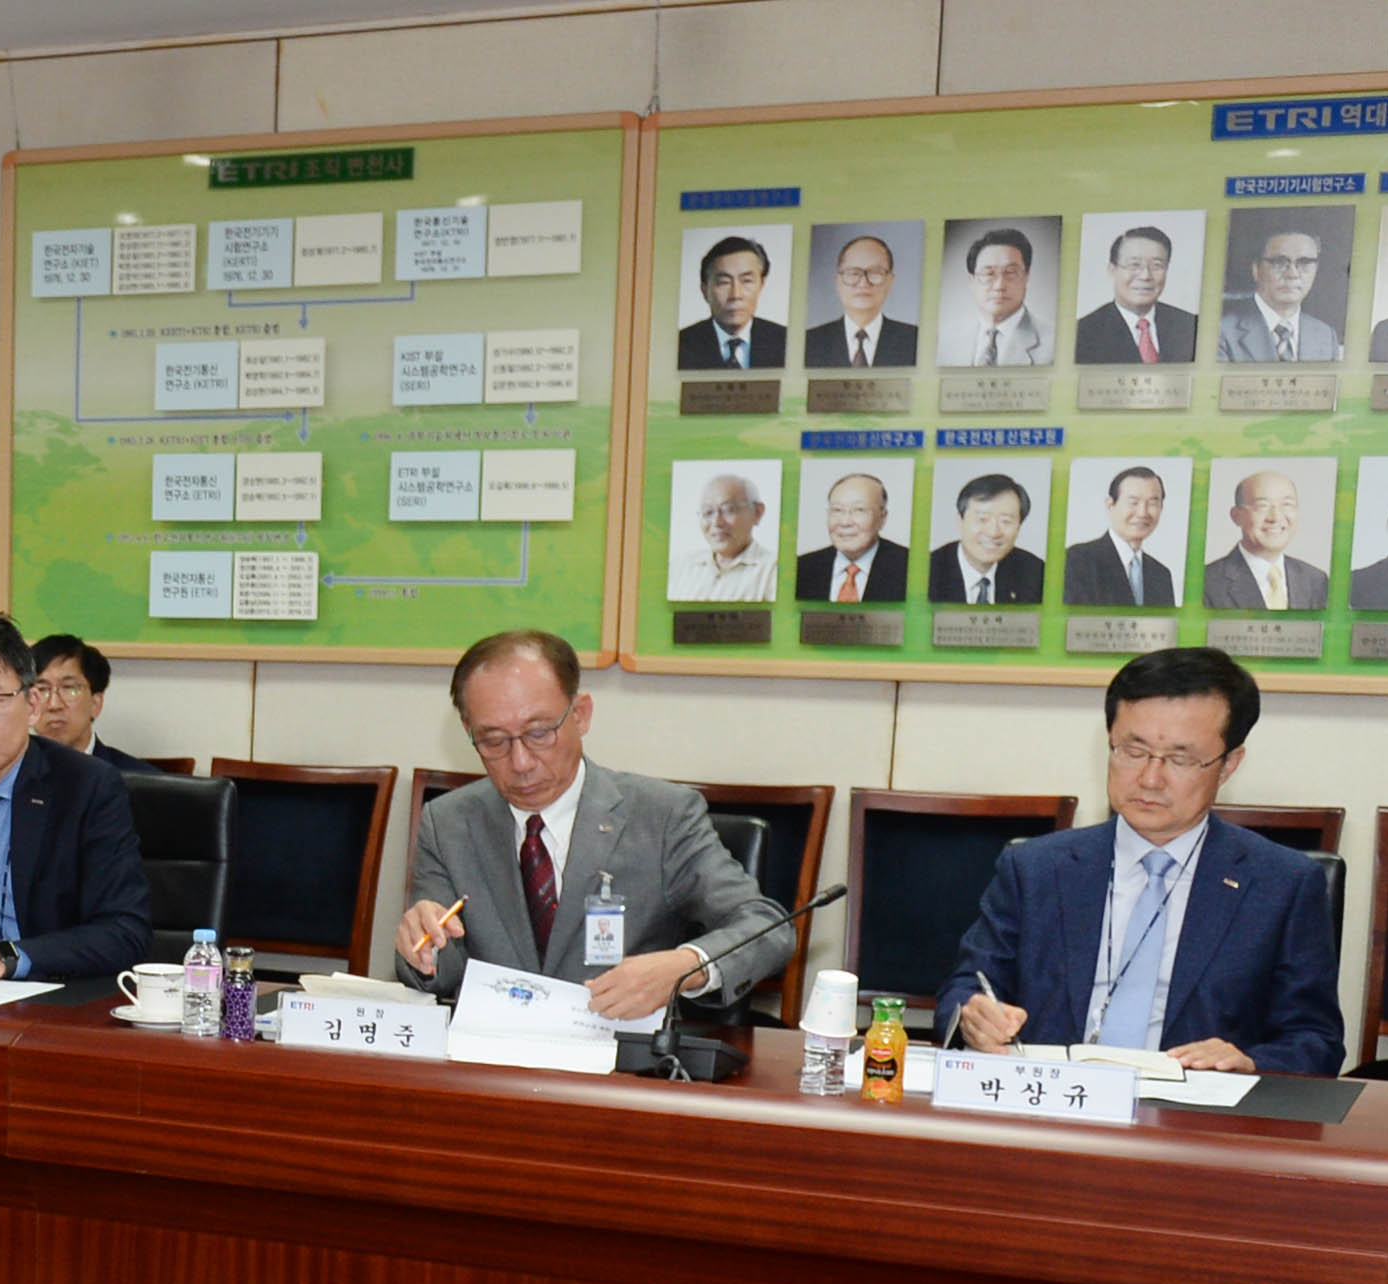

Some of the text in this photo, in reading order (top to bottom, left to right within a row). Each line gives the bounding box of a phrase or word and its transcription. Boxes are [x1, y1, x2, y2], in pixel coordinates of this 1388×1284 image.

[1226, 102, 1387, 131] ETRI 역대
[217, 160, 299, 183] ETRI
[290, 1000, 316, 1011] ETRI
[945, 1059, 974, 1070] ETRI
